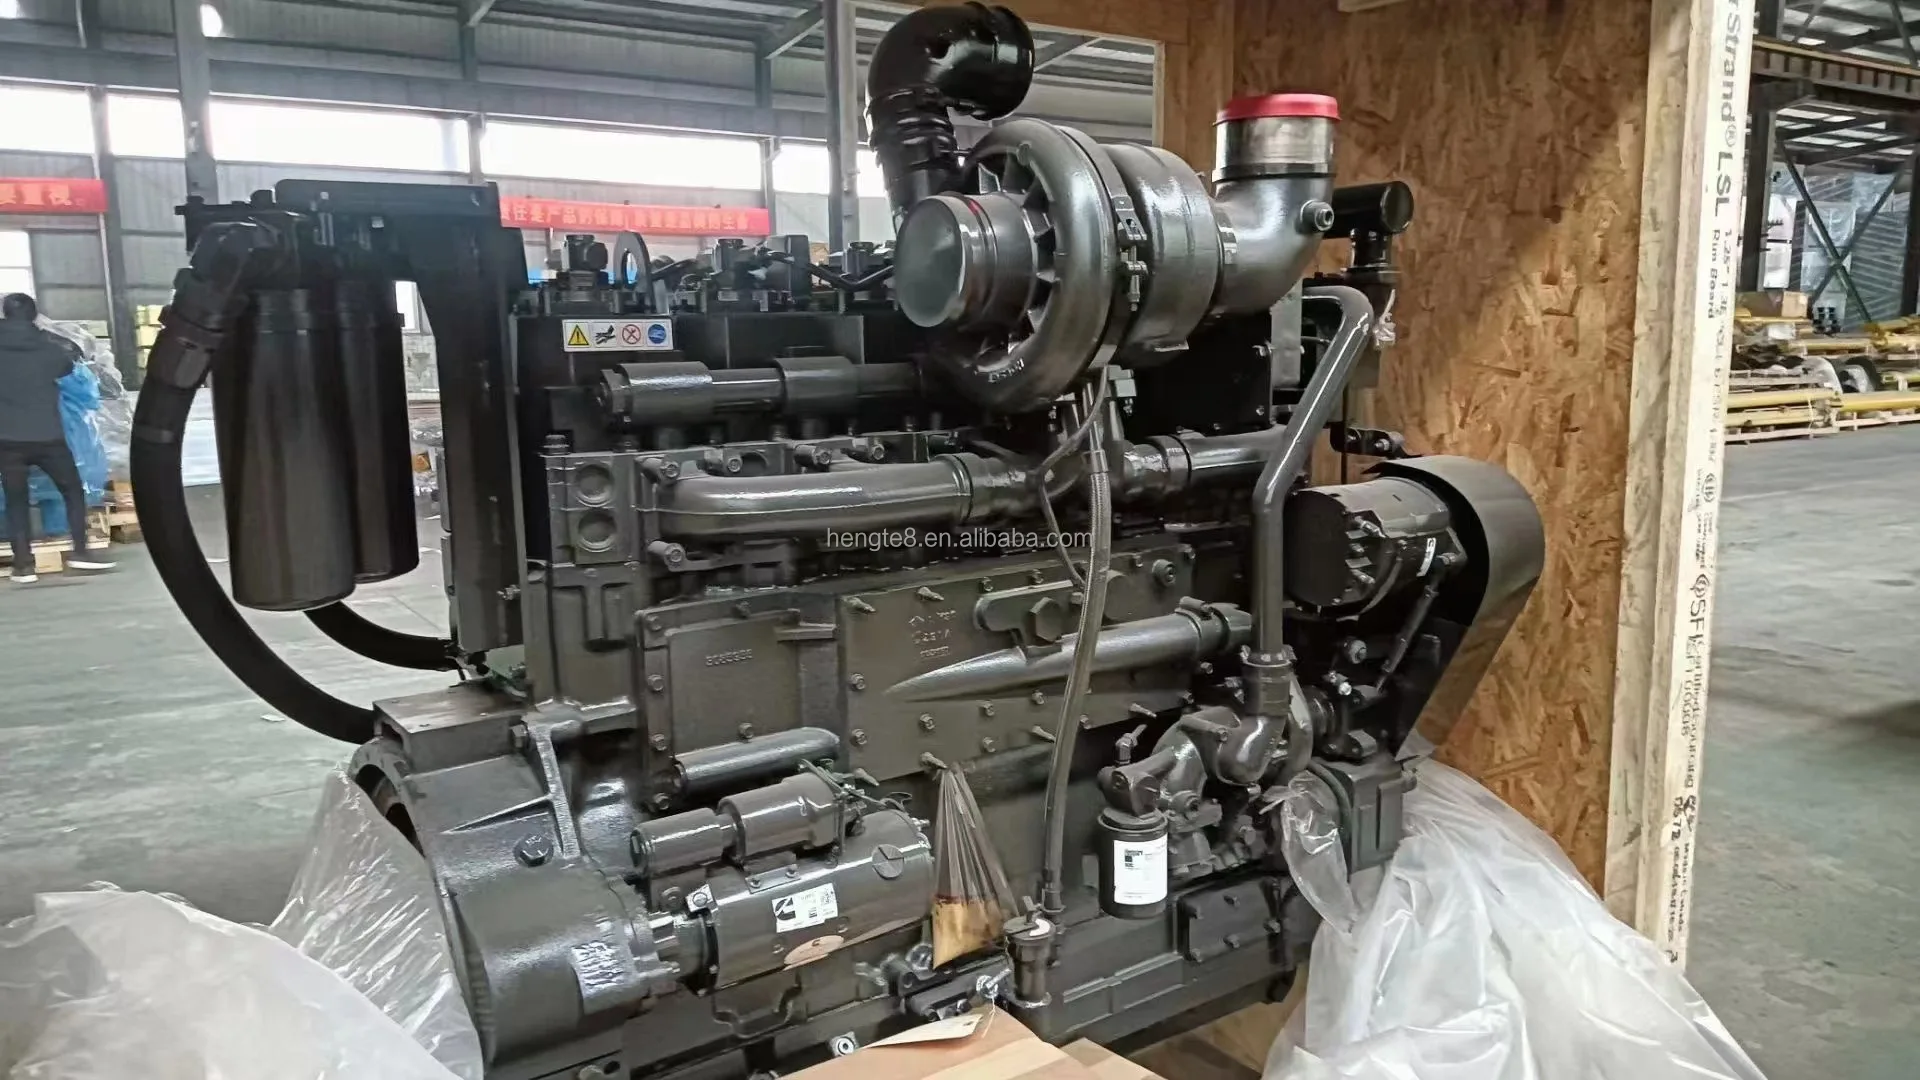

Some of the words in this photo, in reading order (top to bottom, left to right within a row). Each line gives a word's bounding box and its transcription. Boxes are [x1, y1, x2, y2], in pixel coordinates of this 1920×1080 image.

[1715, 151, 1733, 217] LSL
[1711, 229, 1721, 262] Rim
[1707, 268, 1718, 319] Board
